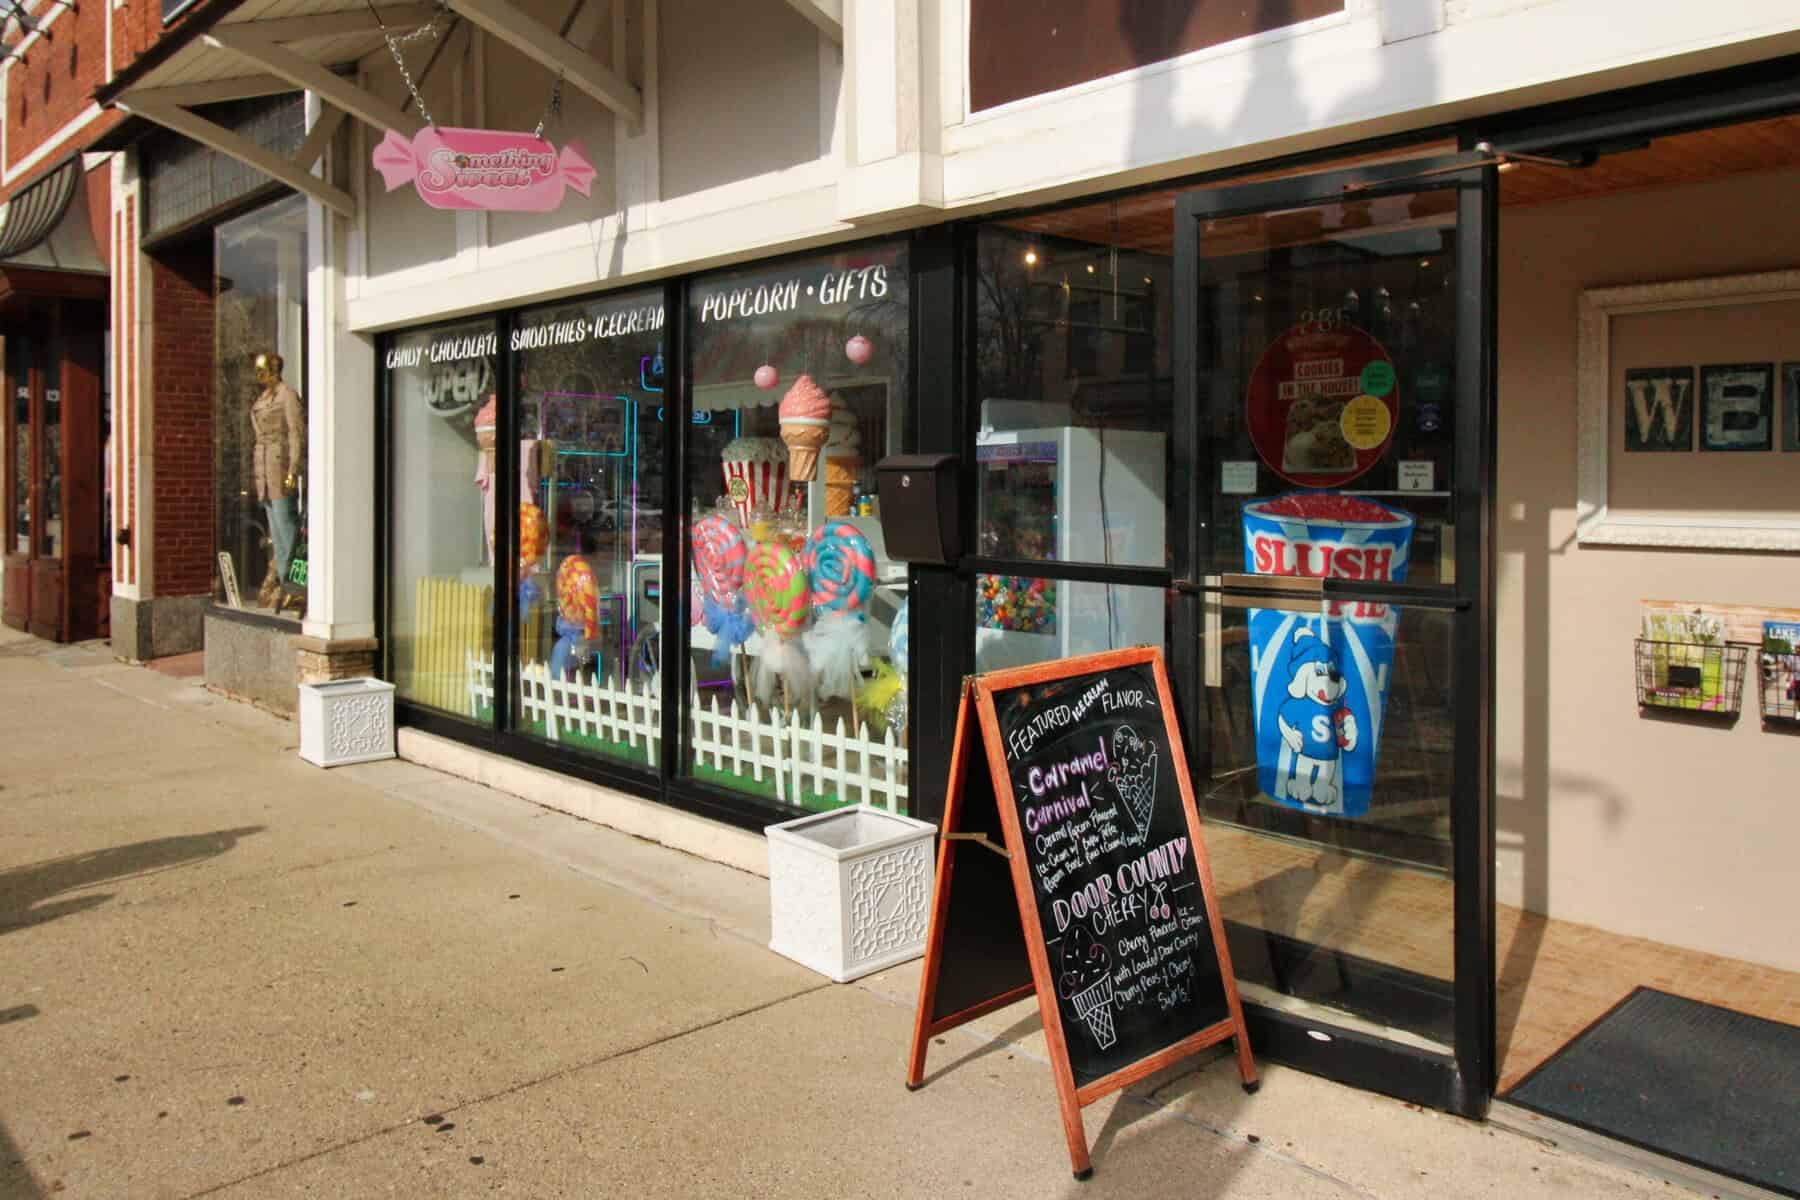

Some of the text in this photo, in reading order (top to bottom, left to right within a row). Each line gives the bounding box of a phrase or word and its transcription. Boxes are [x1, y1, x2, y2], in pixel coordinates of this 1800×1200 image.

[701, 263, 888, 323] POPCORN GIFTS
[386, 344, 422, 369] CANDY
[510, 321, 585, 351] SMOOTHIES
[1255, 535, 1392, 580] SLUSH
[1009, 704, 1072, 760] FEATURED
[1072, 701, 1086, 721] ICE
[1102, 690, 1143, 713] FLAVOR
[1029, 736, 1109, 795] Caramel
[1026, 781, 1091, 833] Carnival
[1053, 837, 1187, 933] DOOR COUNTY
[1093, 888, 1149, 935] CHERRY
[1119, 934, 1149, 956] Cherry
